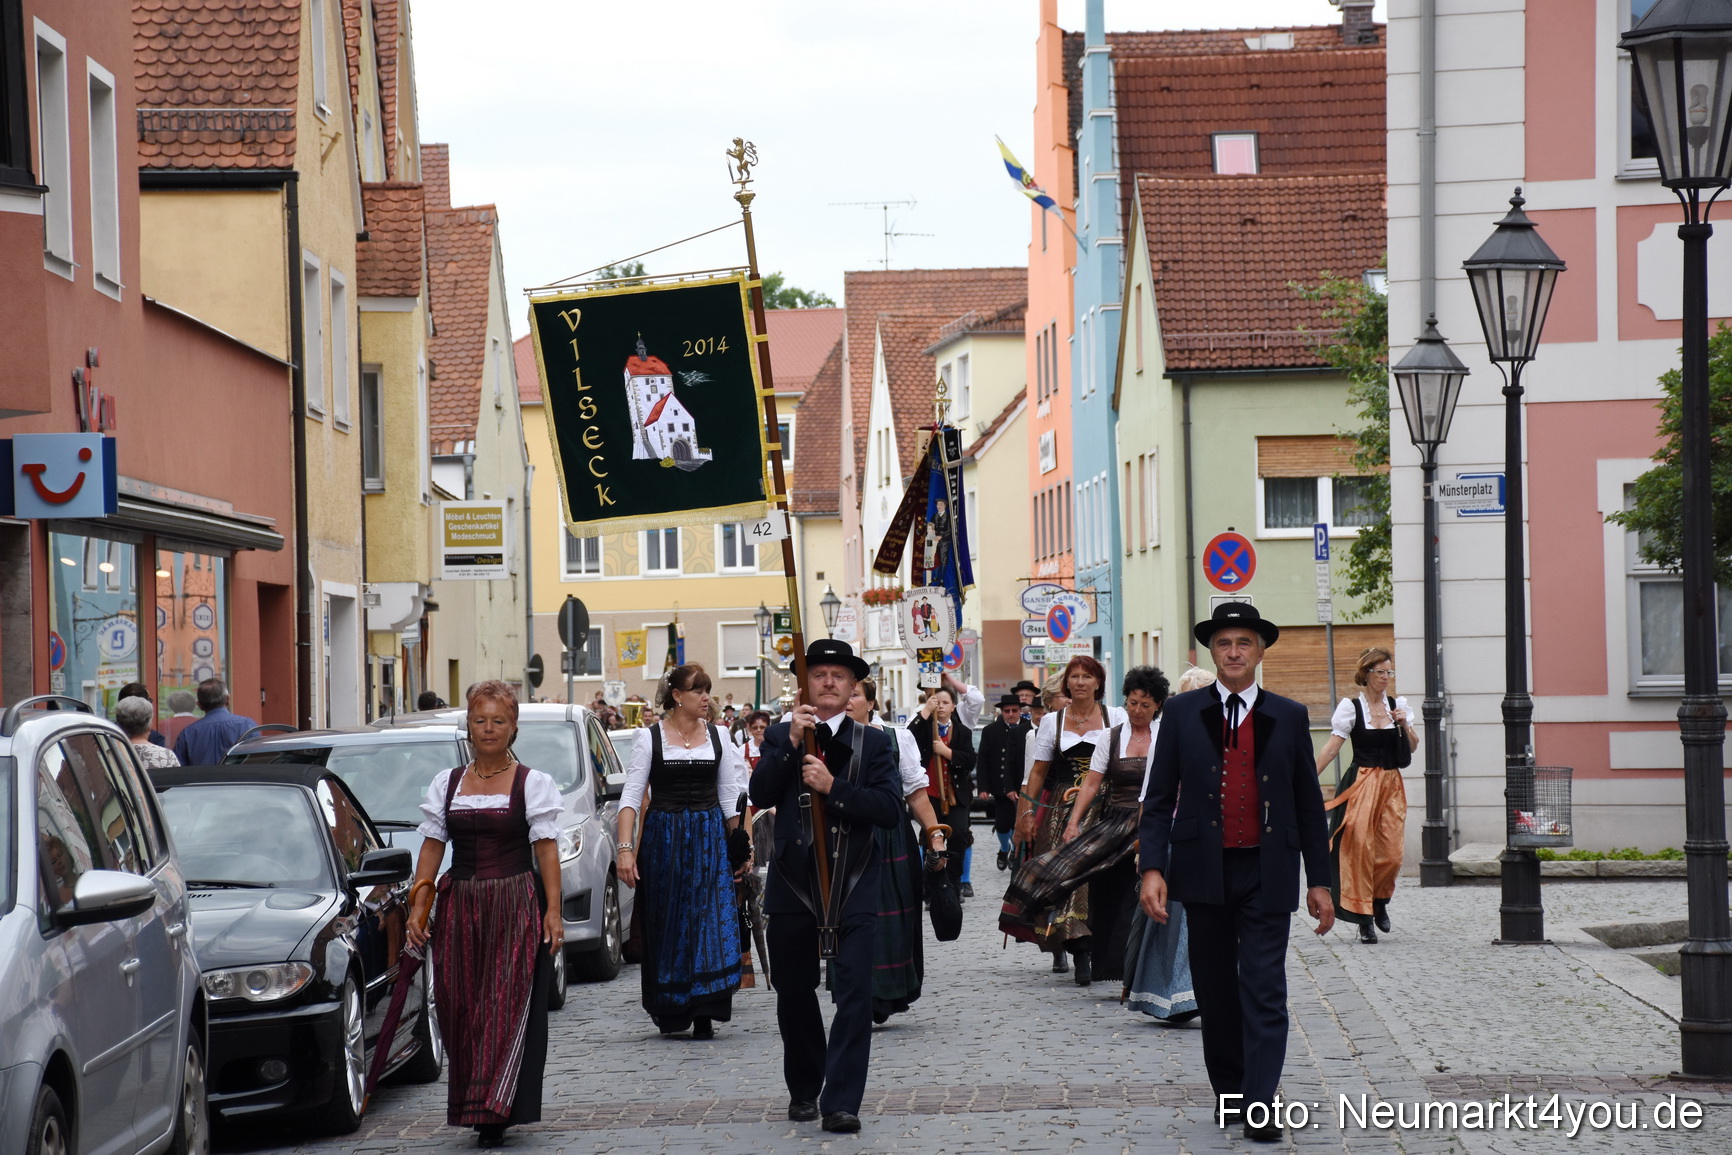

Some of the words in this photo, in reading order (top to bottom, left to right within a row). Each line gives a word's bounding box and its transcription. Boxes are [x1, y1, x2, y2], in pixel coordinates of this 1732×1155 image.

[682, 335, 730, 358] 2014
[557, 308, 617, 507] VILSECK
[1439, 483, 1493, 499] Münsterplatz
[445, 513, 465, 521] Möbel
[472, 512, 502, 520] Leuchten
[448, 522, 499, 530] Geschenkartikel
[752, 520, 773, 537] 42
[451, 532, 497, 540] Modeschmuck
[1316, 527, 1326, 557] P
[476, 556, 502, 565] Design
[926, 675, 938, 684] 43
